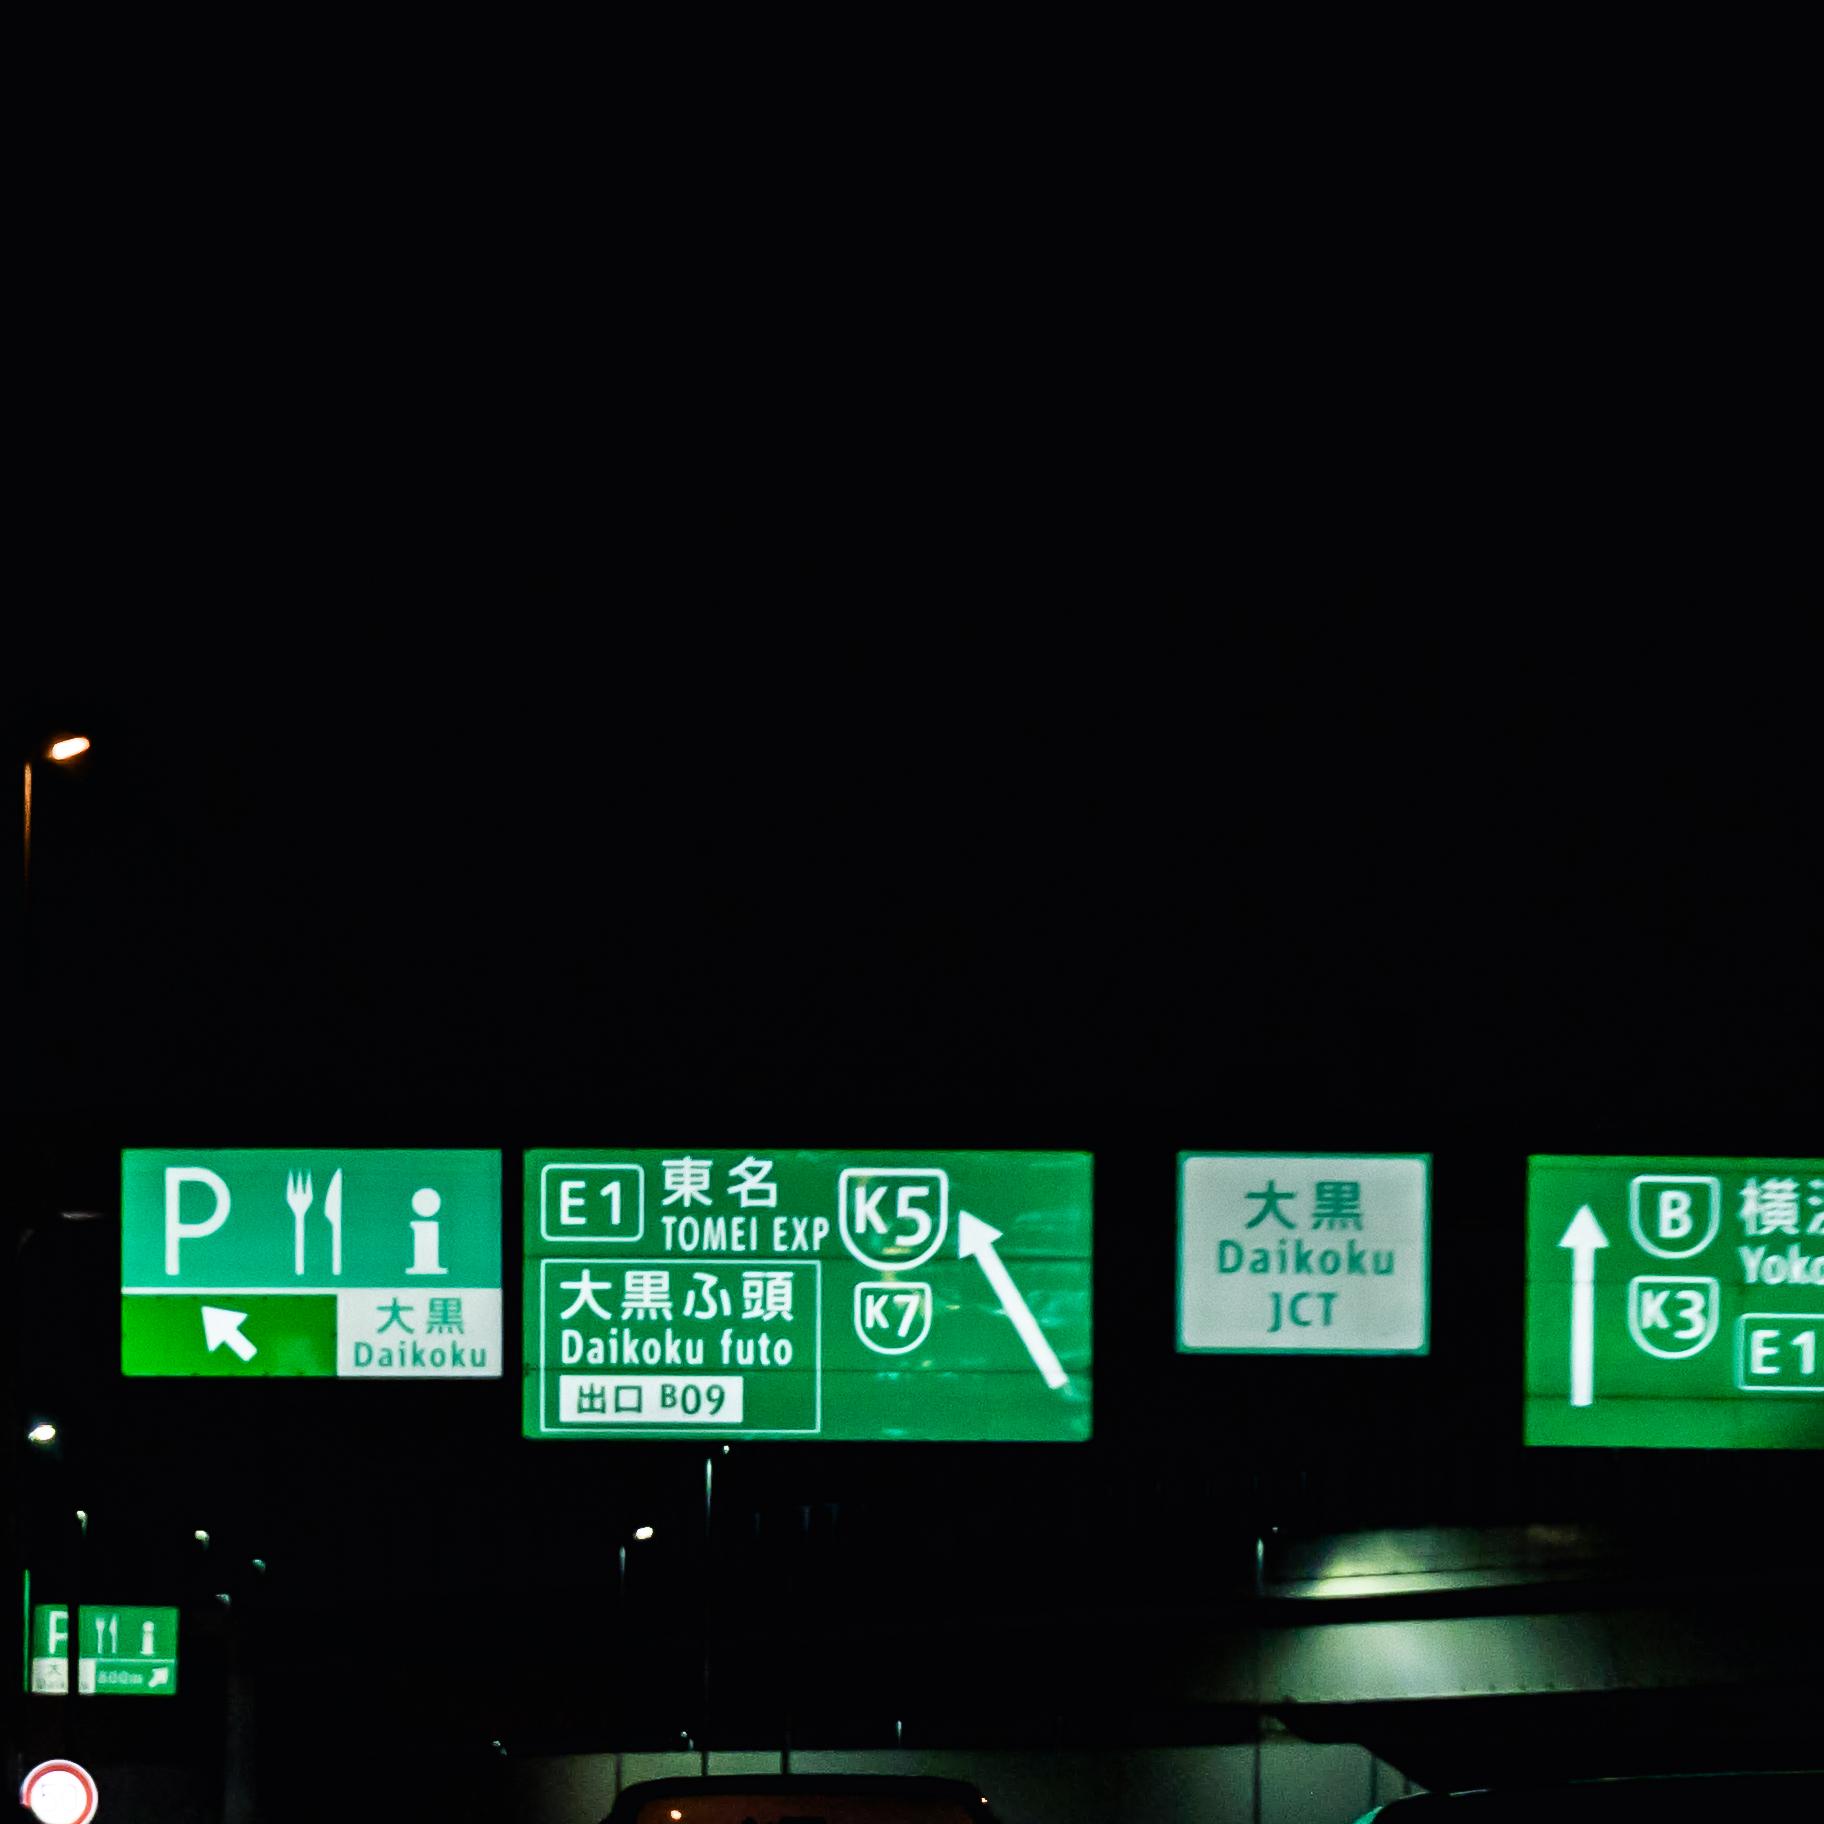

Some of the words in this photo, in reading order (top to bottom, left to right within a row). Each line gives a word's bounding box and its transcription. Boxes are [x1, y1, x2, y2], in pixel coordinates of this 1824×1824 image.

[560, 1181, 621, 1225] E1
[662, 1156, 778, 1208] 東名
[165, 1167, 231, 1275] P
[855, 1186, 932, 1246] K5
[1245, 1180, 1363, 1231] 大黒
[1659, 1191, 1693, 1239] B
[661, 1216, 758, 1251] TOMEI
[773, 1217, 830, 1251] EXP
[1217, 1239, 1395, 1275] Daikoku
[376, 1297, 465, 1335] 大黒
[560, 1269, 794, 1321] 大黒ふ頭
[865, 1294, 920, 1338] K7
[1267, 1292, 1338, 1333] JCT
[1641, 1290, 1706, 1338] K3
[354, 1341, 488, 1368] Daikoku
[561, 1328, 704, 1365] Daikoku
[721, 1328, 793, 1366] futo
[577, 1384, 642, 1414] 出口
[661, 1384, 725, 1415] B09
